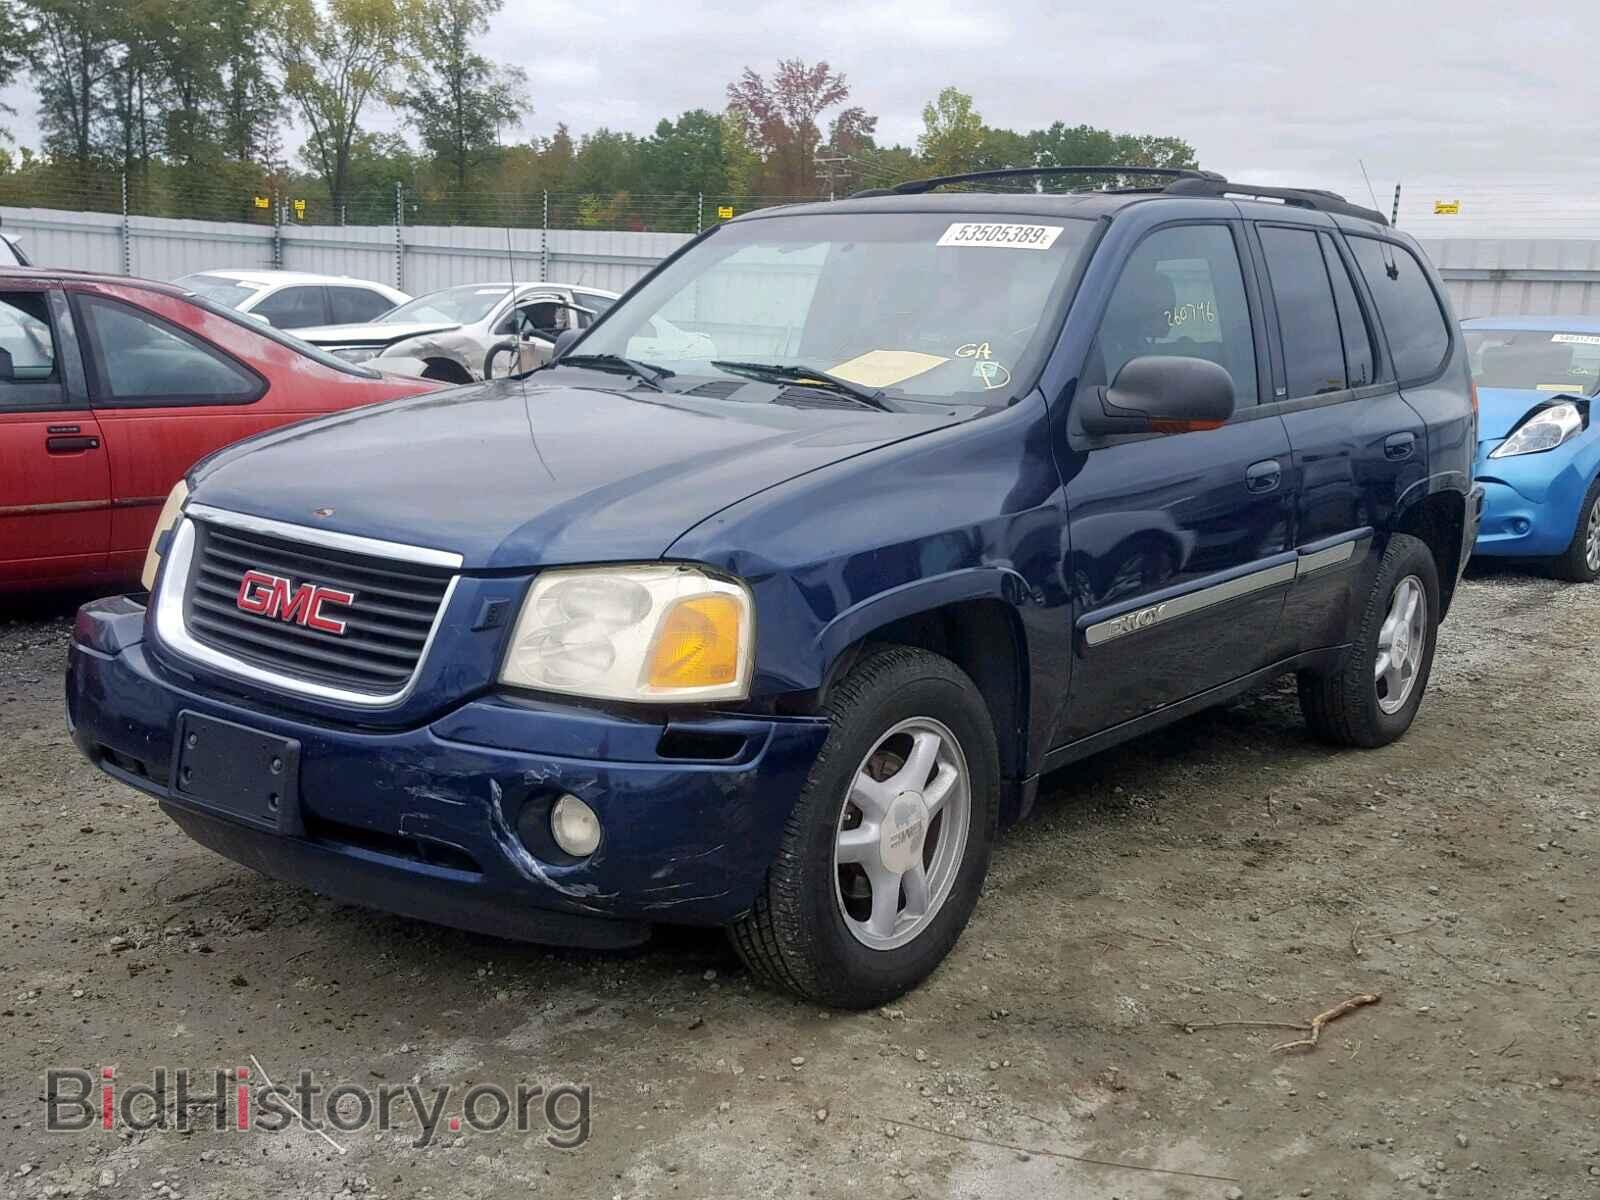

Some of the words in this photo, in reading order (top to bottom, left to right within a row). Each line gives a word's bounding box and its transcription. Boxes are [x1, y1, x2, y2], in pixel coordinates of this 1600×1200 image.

[954, 224, 1046, 244] 53505389
[954, 342, 993, 360] GA
[236, 569, 355, 636] GMC
[1104, 603, 1168, 636] ENVOY
